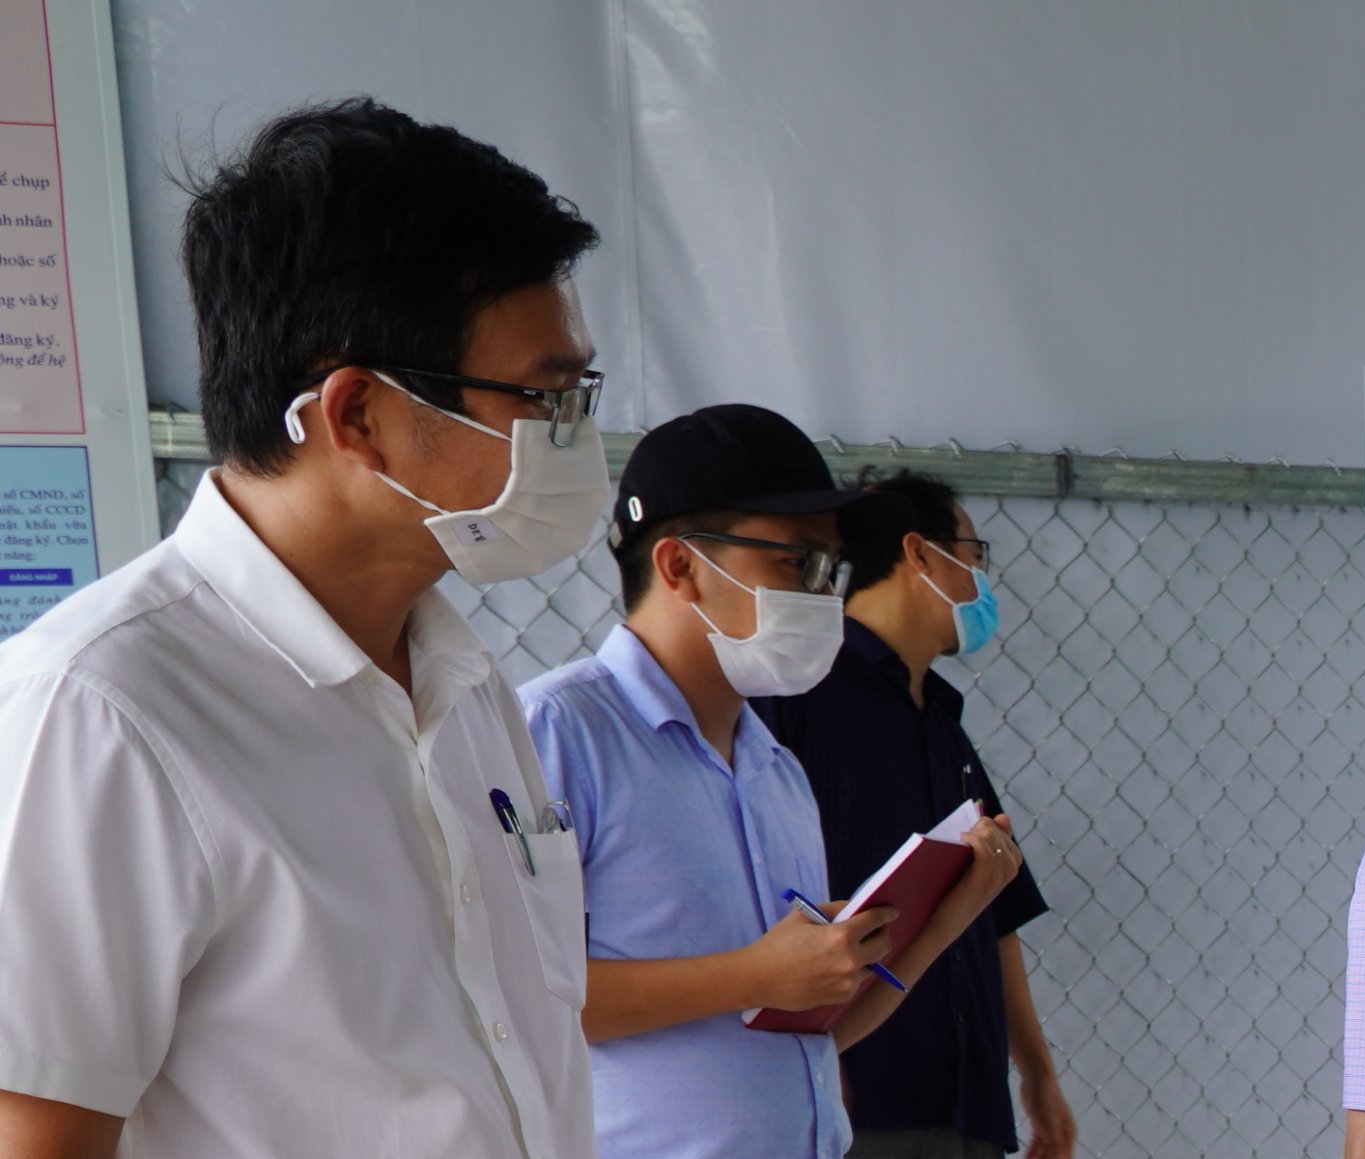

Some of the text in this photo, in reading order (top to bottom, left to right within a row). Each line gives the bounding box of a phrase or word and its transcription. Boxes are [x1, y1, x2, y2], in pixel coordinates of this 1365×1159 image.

[12, 174, 50, 191] chụp
[15, 214, 53, 228] nhân
[20, 293, 37, 307] và
